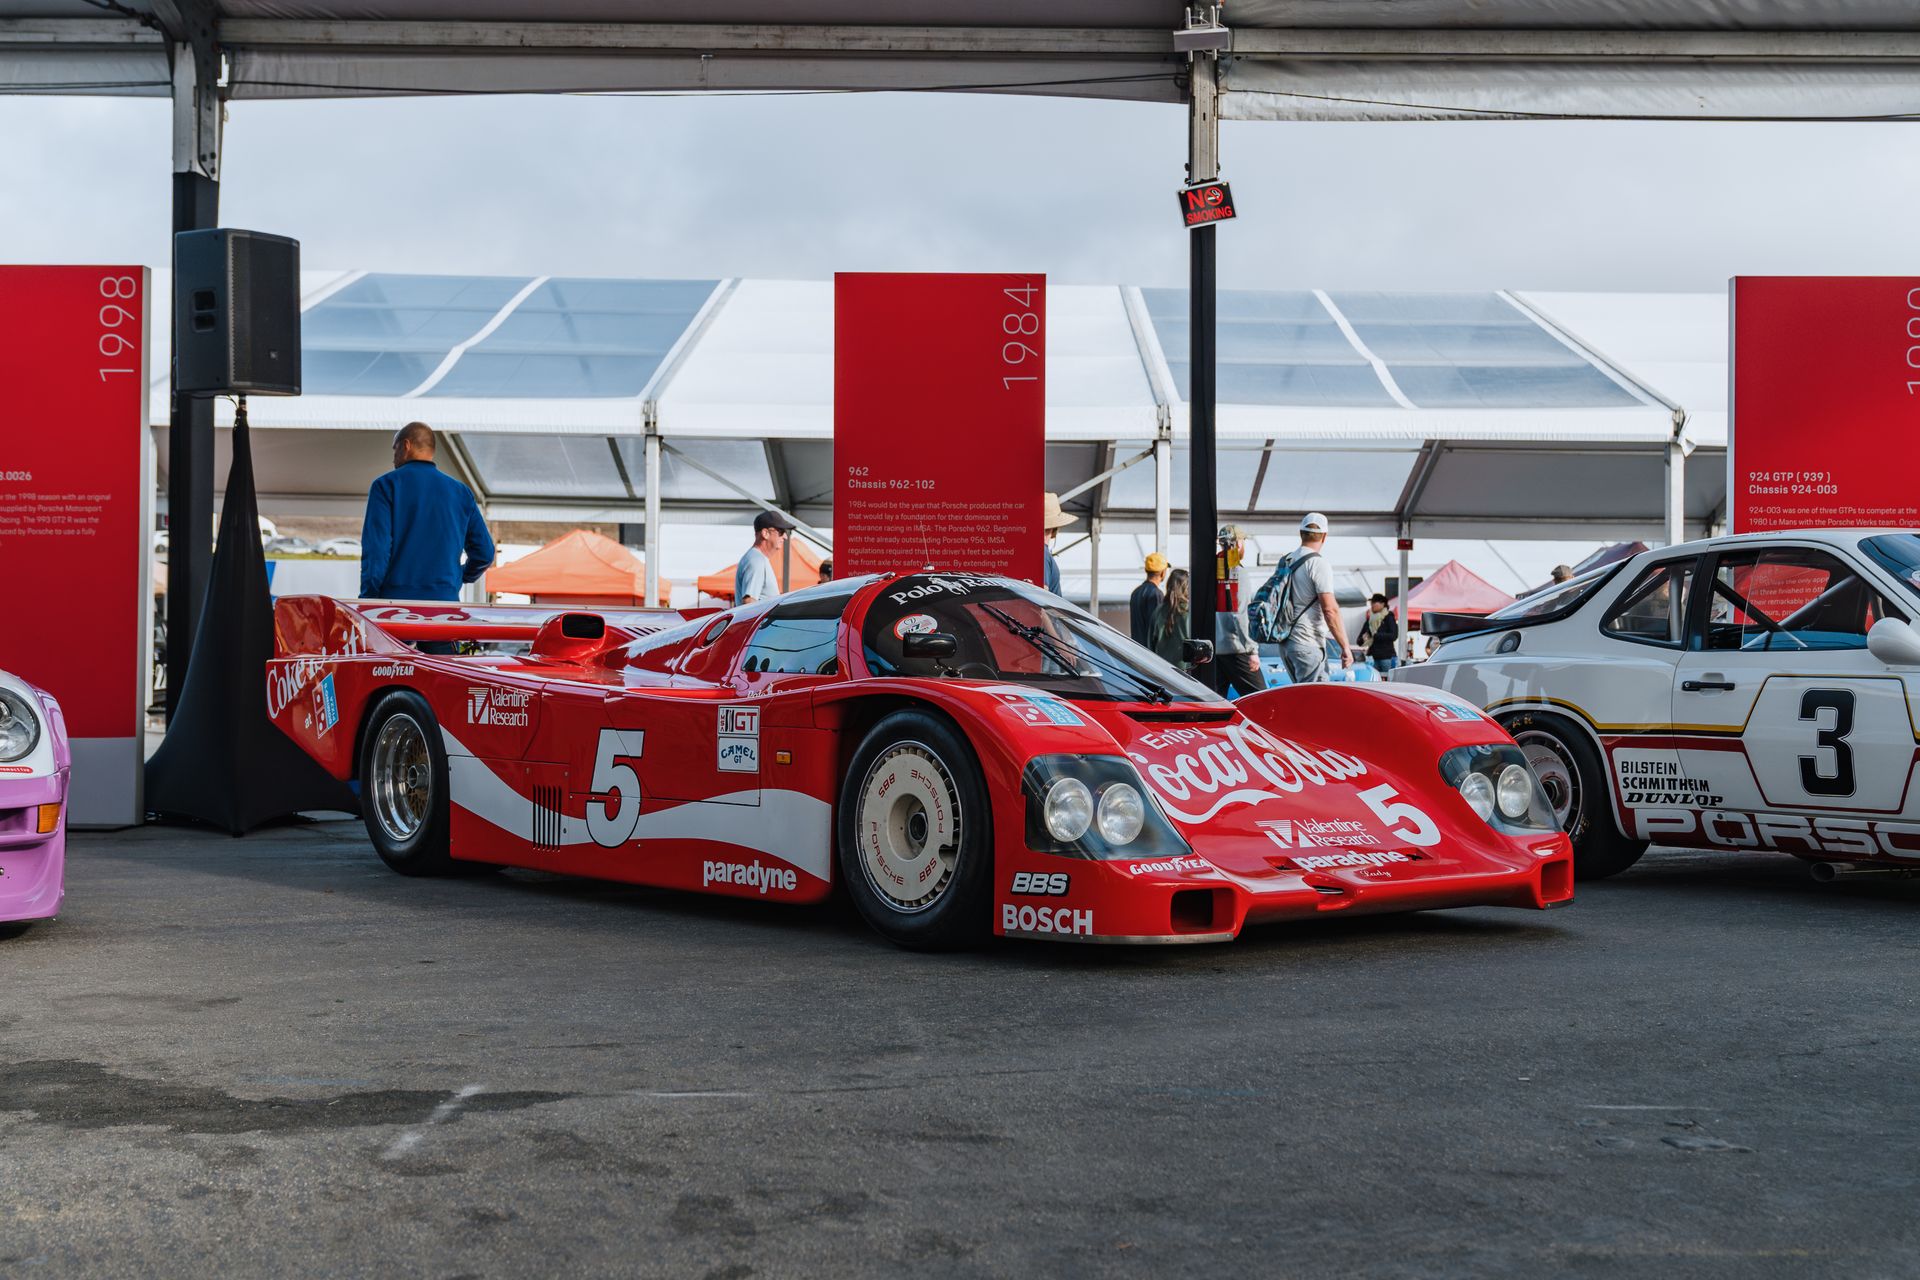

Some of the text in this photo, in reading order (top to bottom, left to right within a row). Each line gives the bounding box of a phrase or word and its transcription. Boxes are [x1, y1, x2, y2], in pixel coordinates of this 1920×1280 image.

[1187, 206, 1233, 224] SMOKING
[99, 276, 137, 382] 1998
[1003, 283, 1039, 390] 1984
[848, 466, 869, 476] 962
[1750, 472, 1770, 482] 924
[1773, 472, 1794, 482] GTP
[1804, 472, 1824, 482] 939
[848, 479, 935, 489] Chassis 962-102
[1749, 484, 1838, 494] Chassis 924-003
[1866, 507, 1896, 516] compete
[1750, 518, 1767, 526] 1980
[1769, 518, 1777, 526] Le
[1778, 518, 1797, 526] Mans
[1799, 518, 1814, 526] with
[1815, 518, 1826, 526] the
[1828, 518, 1854, 526] Porsche
[1856, 518, 1877, 526] Werks
[889, 583, 943, 605] Polo
[372, 662, 414, 679] GOODYEAR
[266, 659, 307, 719] Coke
[490, 688, 530, 708] Valentine
[490, 708, 529, 726] Research
[735, 712, 758, 731] GT
[1139, 726, 1208, 750] Enjoy
[1797, 687, 1857, 798] 3
[720, 744, 756, 761] CAMEL
[734, 754, 742, 764] GT
[1621, 760, 1677, 776] BILSTEIN
[586, 727, 644, 848] 5
[878, 772, 896, 798] BBS
[910, 769, 944, 834] PORSCHE
[1624, 792, 1724, 806] DUNLOP
[1356, 783, 1442, 846] 5
[1293, 818, 1368, 834] Valentine
[1308, 832, 1382, 847] Research
[871, 821, 904, 886] PORSCHE
[1291, 849, 1409, 872] paradyne
[919, 858, 937, 883] BBS
[1129, 857, 1212, 876] GOODYEA
[703, 860, 797, 894] paradyne
[1011, 872, 1069, 894] BBS
[1002, 904, 1093, 936] BOSCH
